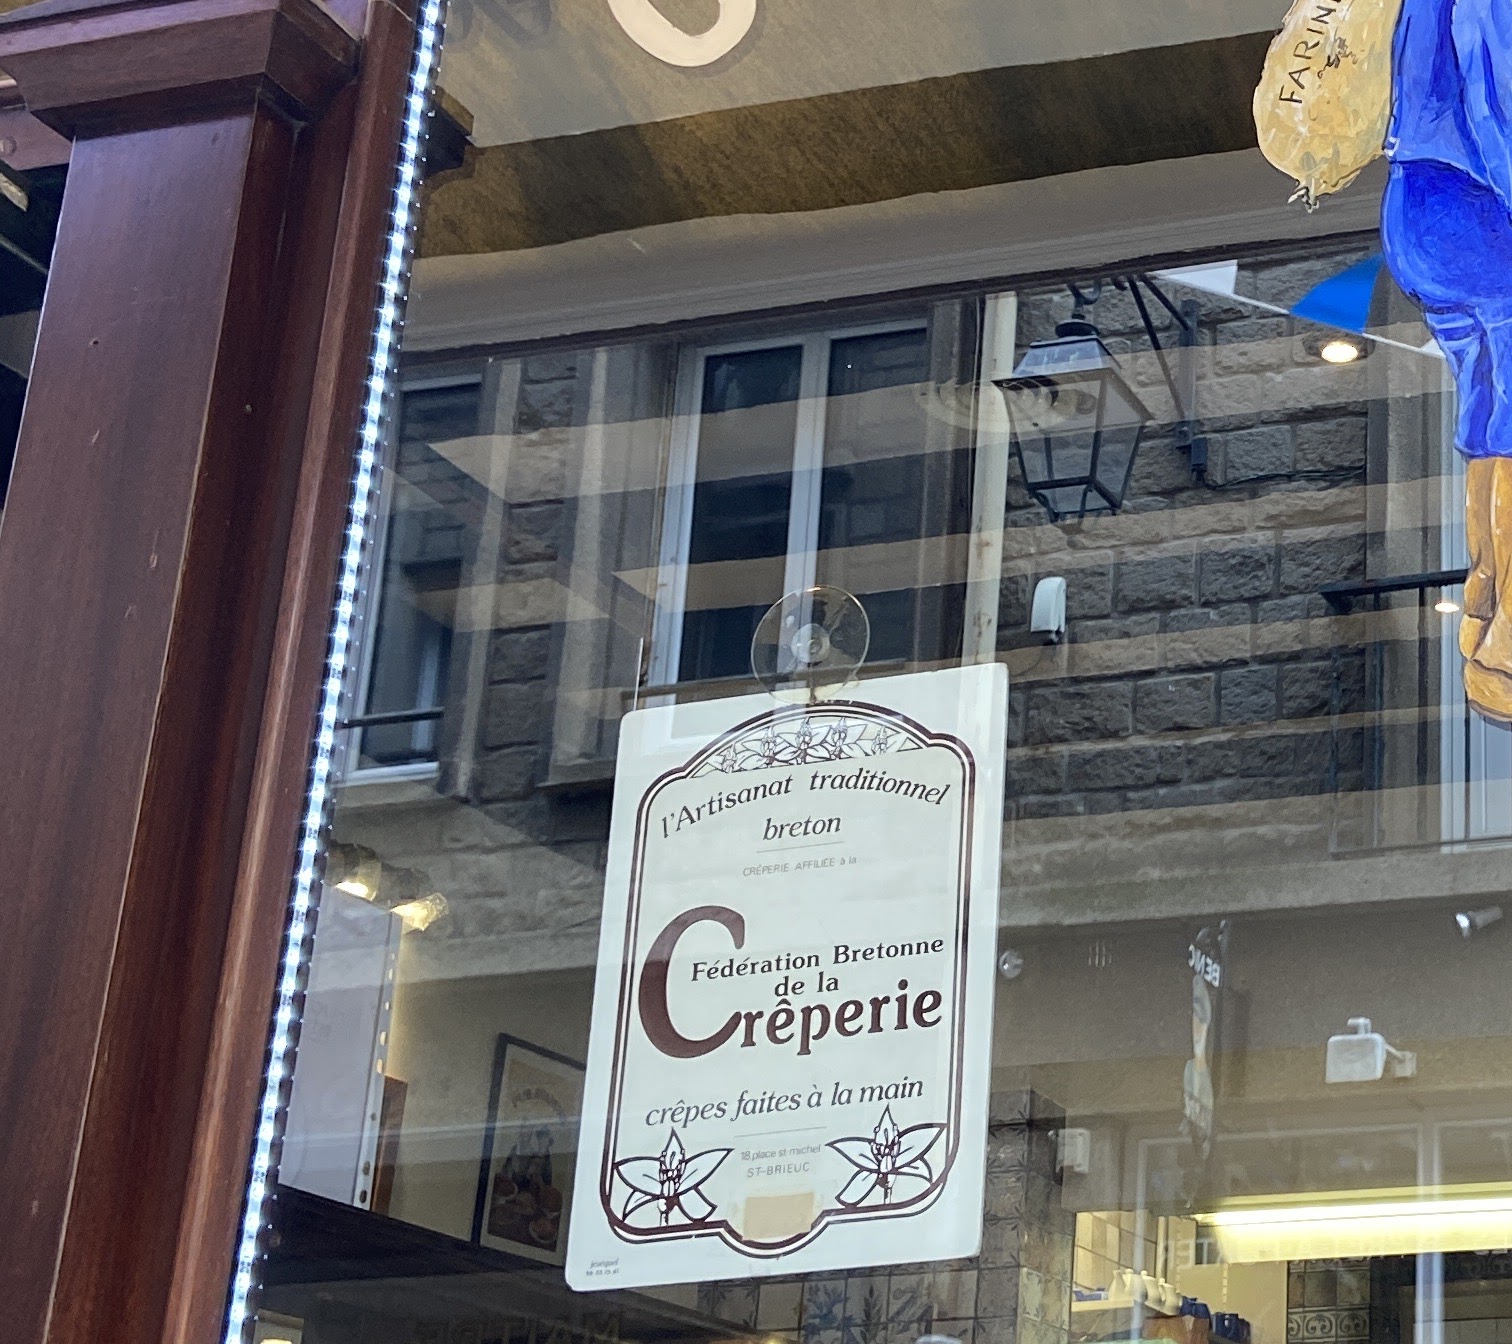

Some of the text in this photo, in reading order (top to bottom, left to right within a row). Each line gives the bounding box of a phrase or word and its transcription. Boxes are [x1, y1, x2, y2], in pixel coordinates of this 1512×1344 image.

[662, 768, 951, 838] l'Artisanat traditionnel
[763, 816, 842, 841] breton
[794, 856, 835, 871] AFFILIÉE
[848, 855, 857, 865] la
[692, 939, 944, 981] Fédération Bretonne
[638, 905, 943, 1058] Crêperie
[774, 971, 839, 997] de la
[645, 1076, 923, 1129] crêpes faites à la main
[747, 1161, 811, 1178] ST-BRIEUC
